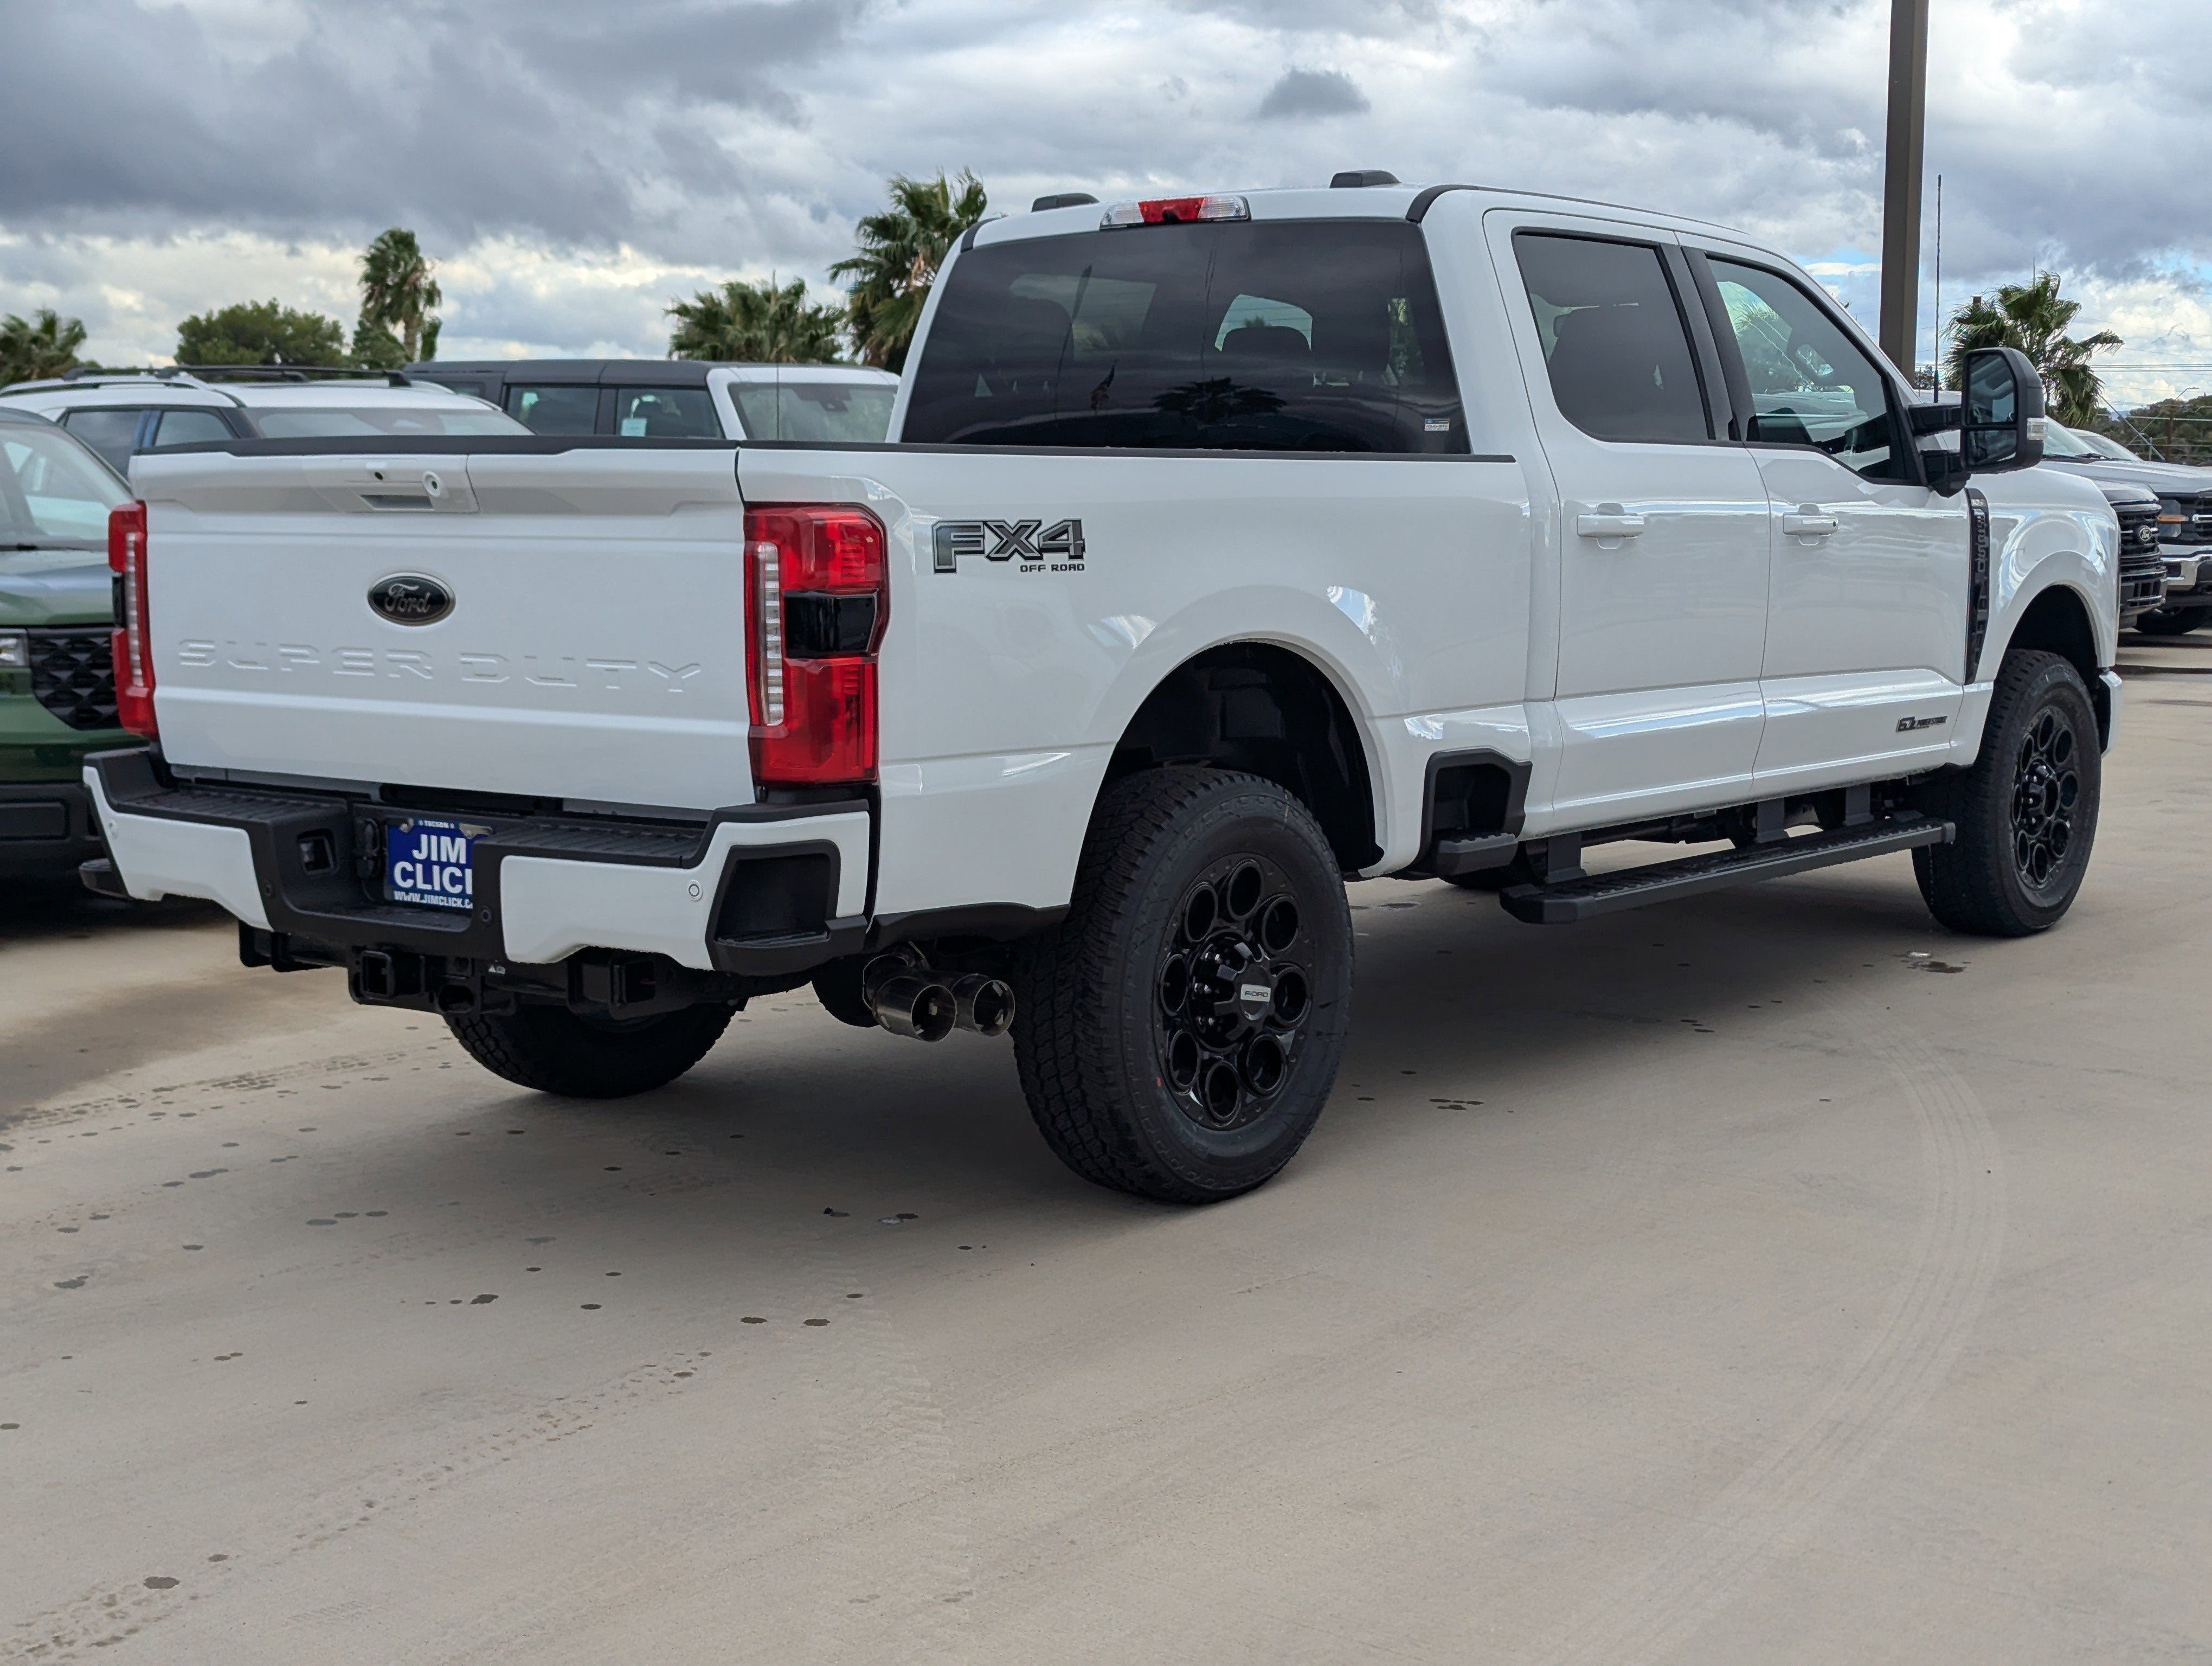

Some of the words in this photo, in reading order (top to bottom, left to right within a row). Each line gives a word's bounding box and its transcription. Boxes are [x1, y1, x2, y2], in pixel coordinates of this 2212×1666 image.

[931, 518, 1086, 574] FX4
[1051, 563, 1085, 572] ROAD
[384, 583, 431, 613] Ford
[179, 639, 433, 679] SUPER
[460, 652, 701, 693] DUTY
[411, 834, 467, 864] JIM
